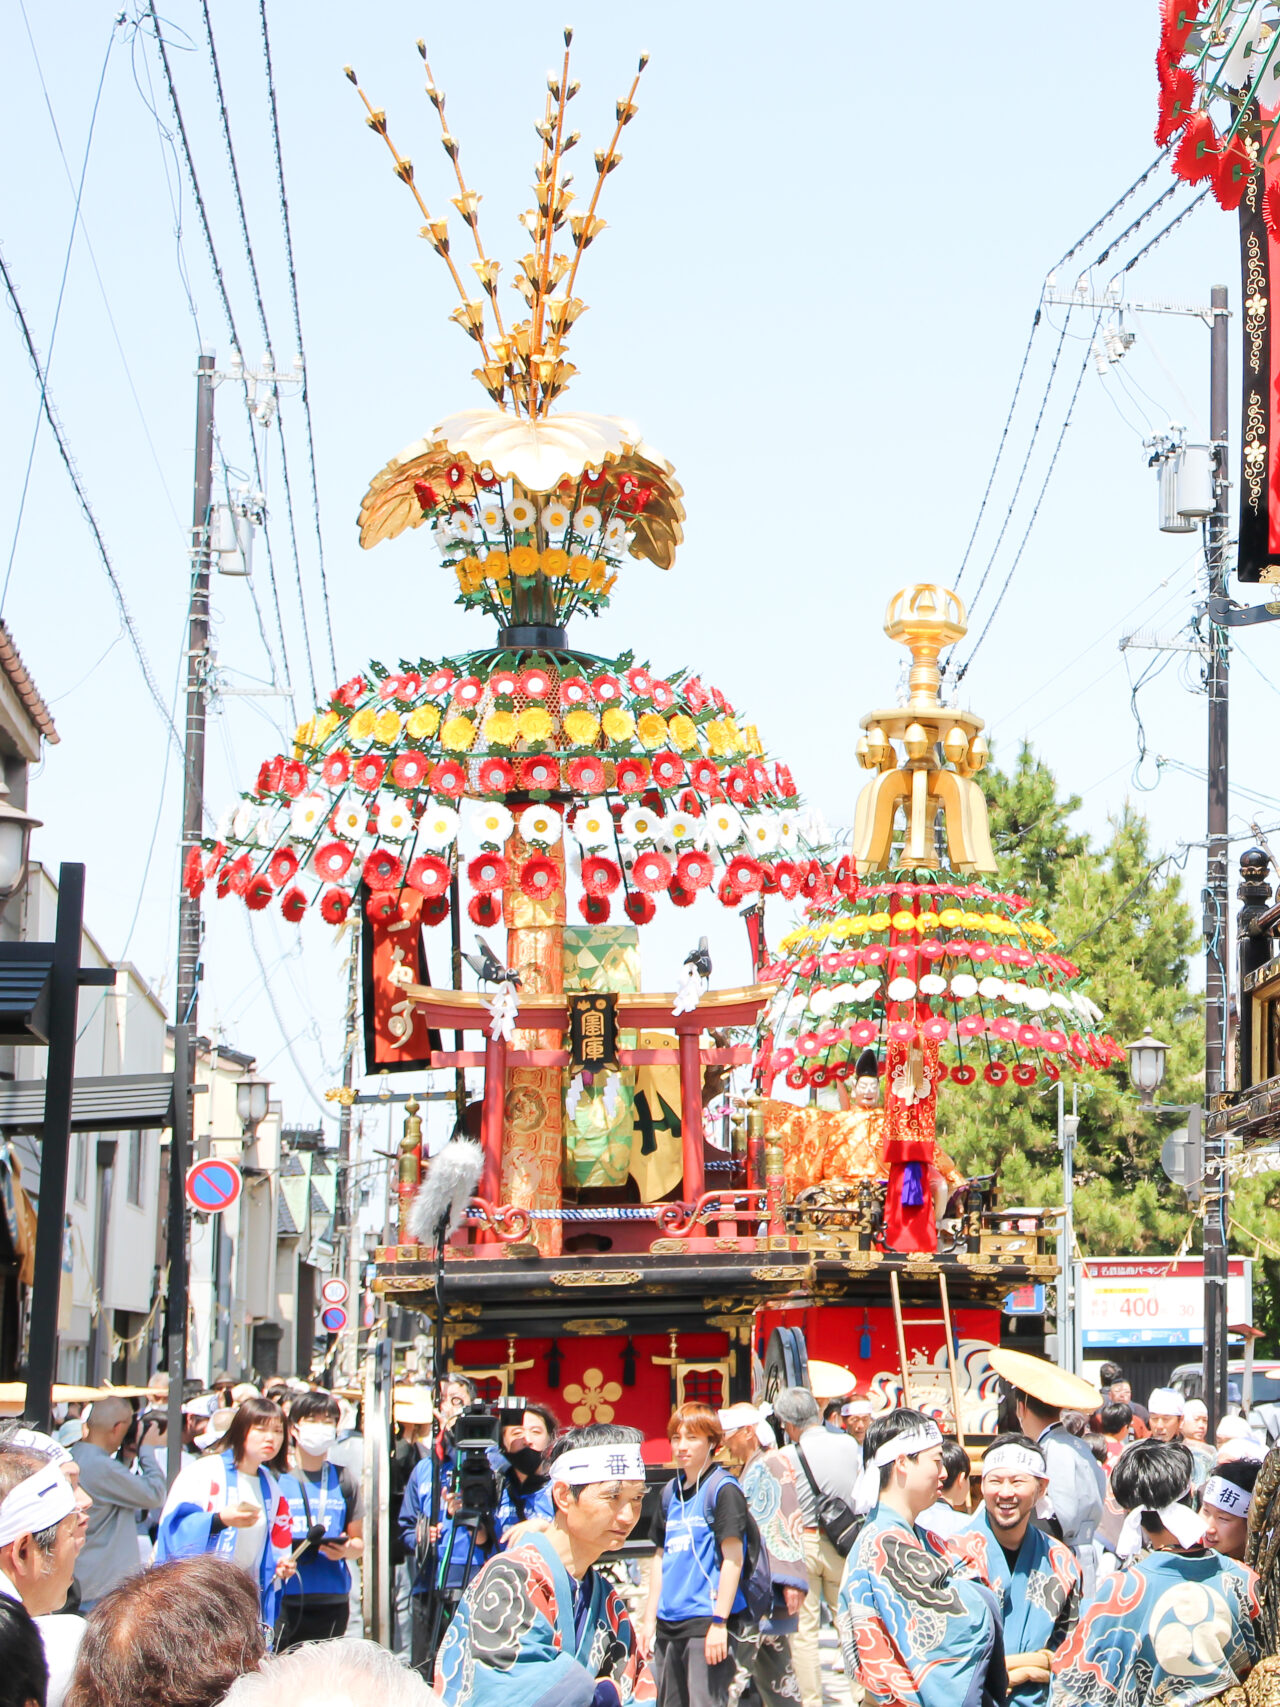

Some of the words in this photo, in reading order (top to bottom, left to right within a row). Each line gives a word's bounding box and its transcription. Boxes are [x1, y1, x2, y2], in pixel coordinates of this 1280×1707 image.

[1119, 1297, 1160, 1317] 400
[1179, 1305, 1195, 1317] 30
[1206, 1480, 1250, 1514] 番街
